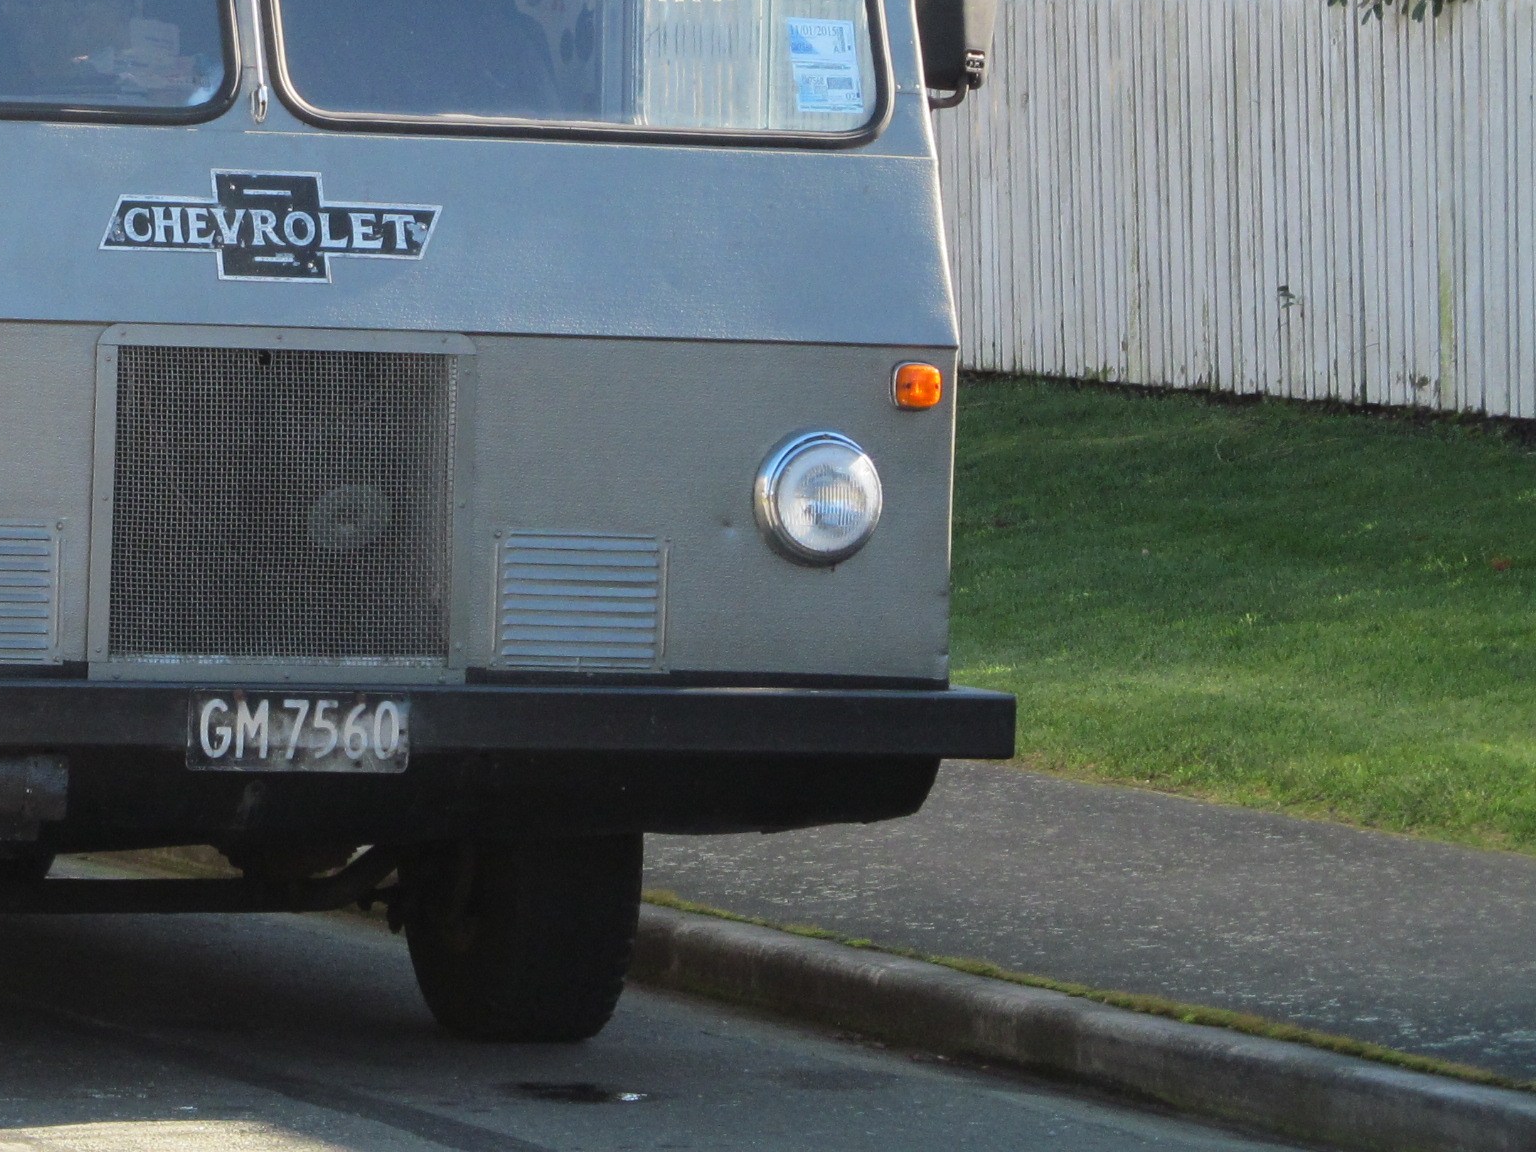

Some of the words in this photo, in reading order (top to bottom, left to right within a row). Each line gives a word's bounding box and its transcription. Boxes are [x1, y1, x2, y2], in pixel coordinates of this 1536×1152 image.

[791, 25, 837, 36] 11/01/2015
[123, 206, 416, 250] CHEVROLET
[199, 698, 269, 759] GM
[283, 699, 400, 760] 7560
